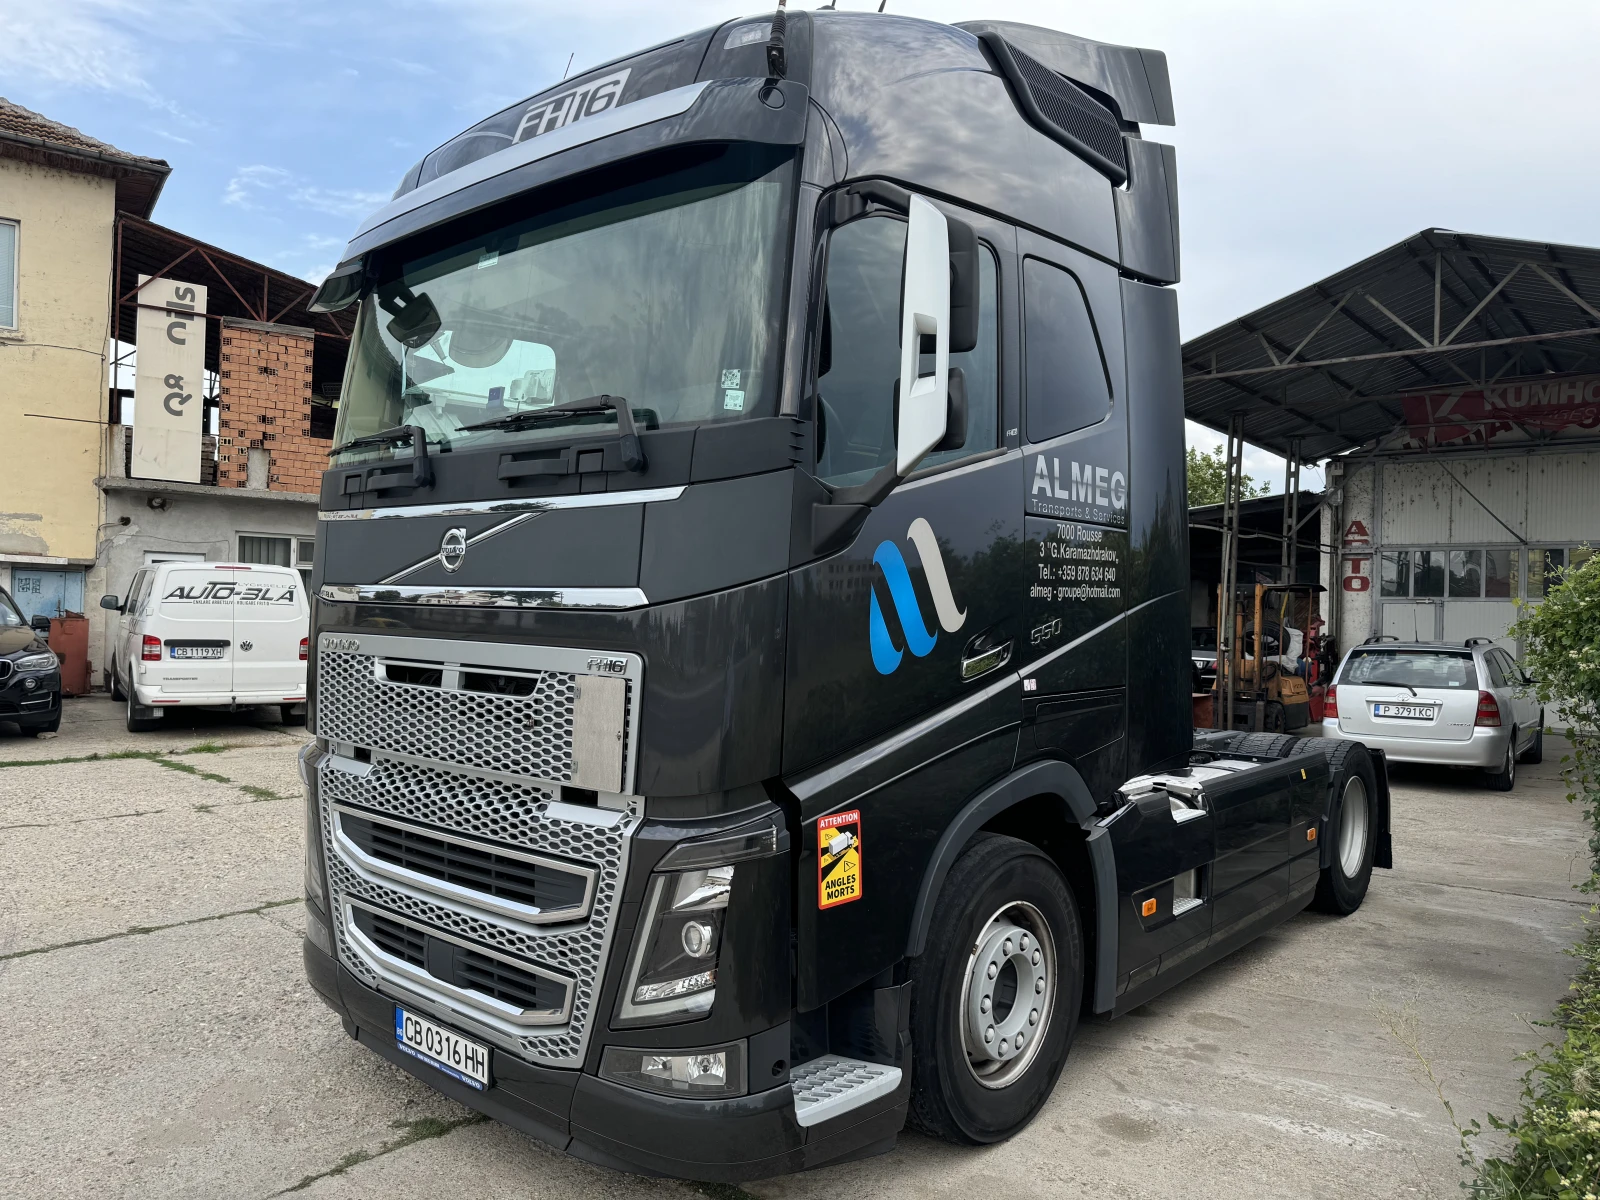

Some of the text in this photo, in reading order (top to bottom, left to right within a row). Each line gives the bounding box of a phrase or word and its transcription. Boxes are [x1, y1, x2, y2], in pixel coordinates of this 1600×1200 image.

[512, 77, 623, 145] FH16
[1031, 454, 1126, 510] ALMEG
[1031, 498, 1125, 525] Transports & Services
[1056, 523, 1103, 543] 7000 Rousse
[441, 546, 464, 556] VOLVO
[1039, 542, 1045, 558] 3
[1038, 563, 1116, 581] Tel.: +359 878 634 640
[1030, 582, 1052, 602] almeg
[1057, 583, 1121, 602] groupe@hotmail.com
[322, 637, 361, 651] VOLVO
[587, 657, 625, 673] FH16
[820, 812, 858, 829] ATTENTION
[825, 873, 856, 891] ANGLES
[826, 884, 855, 901] MORTS
